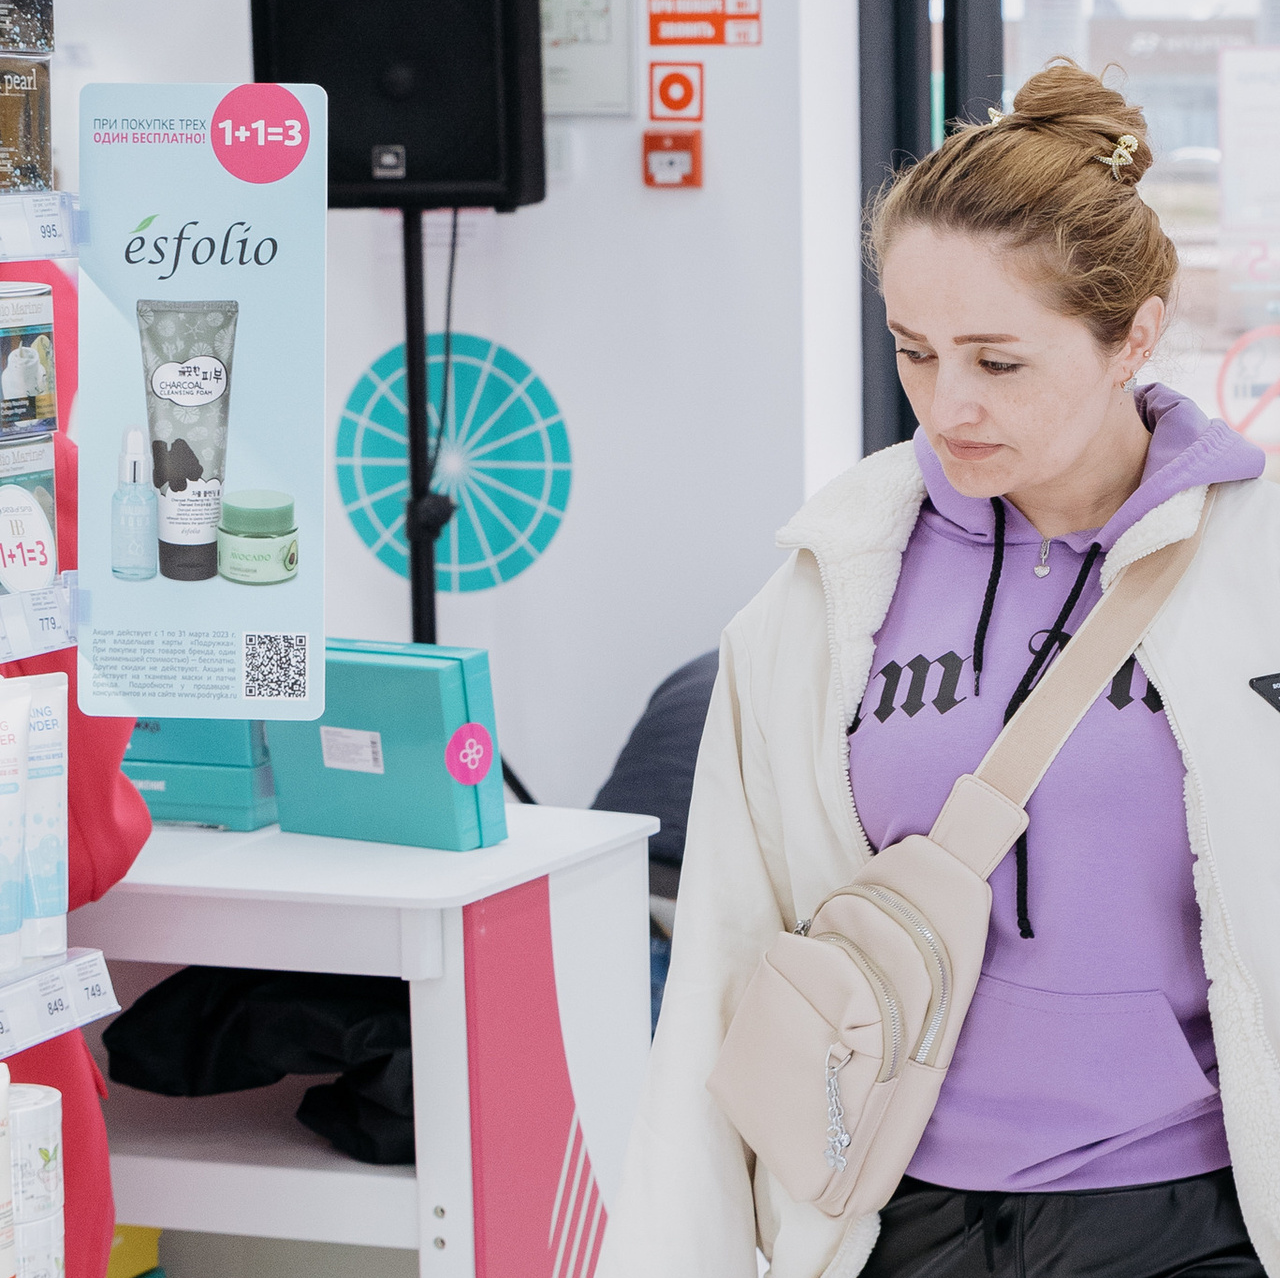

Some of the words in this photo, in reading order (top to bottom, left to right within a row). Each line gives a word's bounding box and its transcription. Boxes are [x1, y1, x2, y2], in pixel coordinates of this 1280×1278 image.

[4, 68, 37, 94] pearl
[93, 118, 117, 130] ПРИ
[121, 119, 175, 130] ПОКУПКЕ
[179, 119, 206, 130] ТРЕХ
[93, 132, 128, 145] ОДИН
[132, 132, 206, 144] БЕСПЛАТНО!
[218, 119, 302, 146] 1+1=3
[40, 224, 58, 238] 995
[201, 367, 223, 383] 피부
[159, 381, 204, 390] CHARCOAL
[39, 617, 57, 631] 779
[146, 656, 189, 664] стоимостью)
[129, 681, 173, 689] Подробности
[84, 984, 101, 1000] 749
[47, 998, 64, 1015] 849
